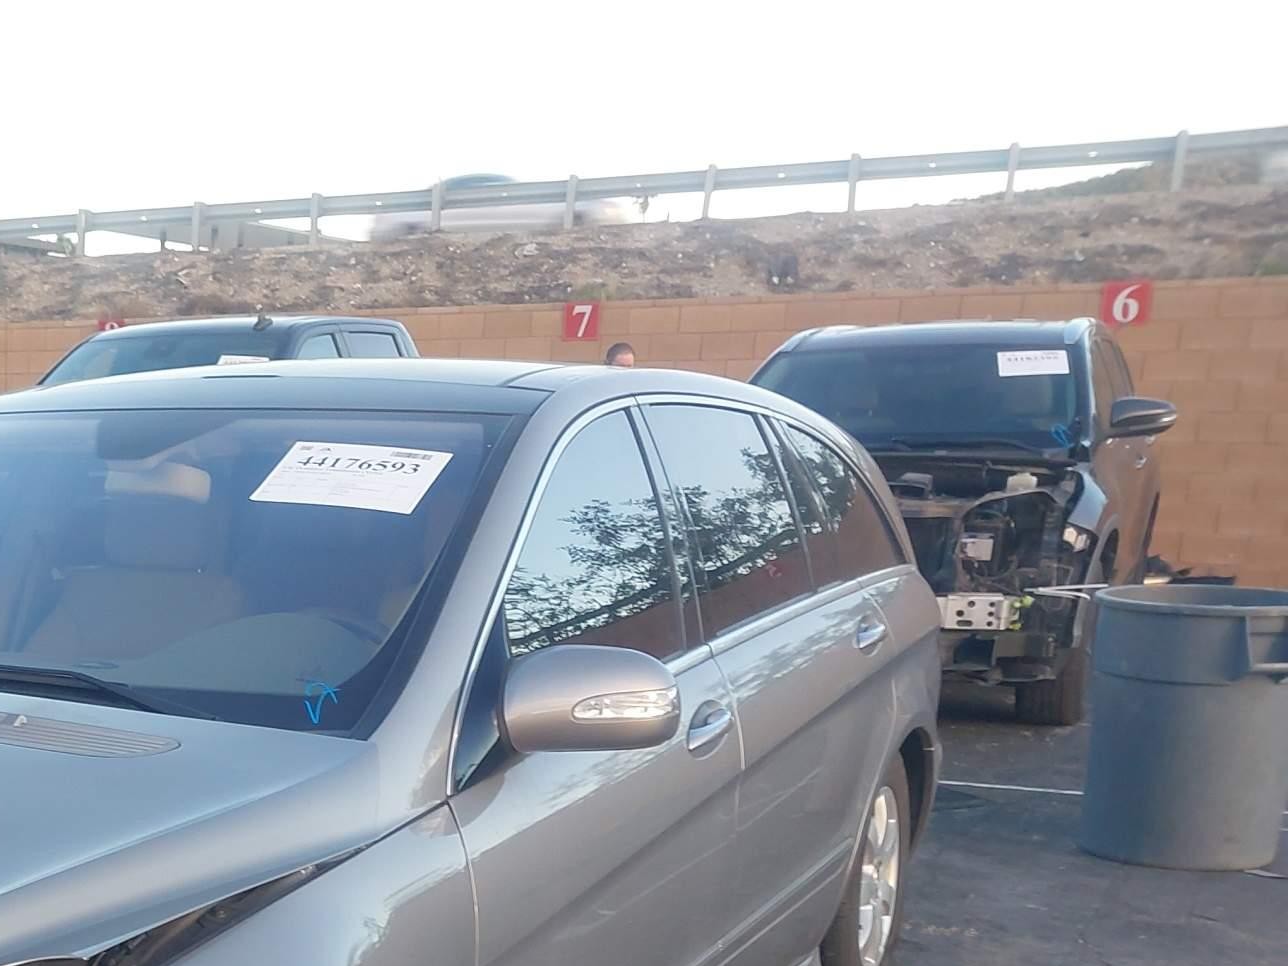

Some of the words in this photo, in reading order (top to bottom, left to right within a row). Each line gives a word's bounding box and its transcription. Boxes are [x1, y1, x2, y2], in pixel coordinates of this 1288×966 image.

[1113, 285, 1141, 322] 6
[572, 304, 593, 337] 7
[297, 455, 421, 475] 44176593
